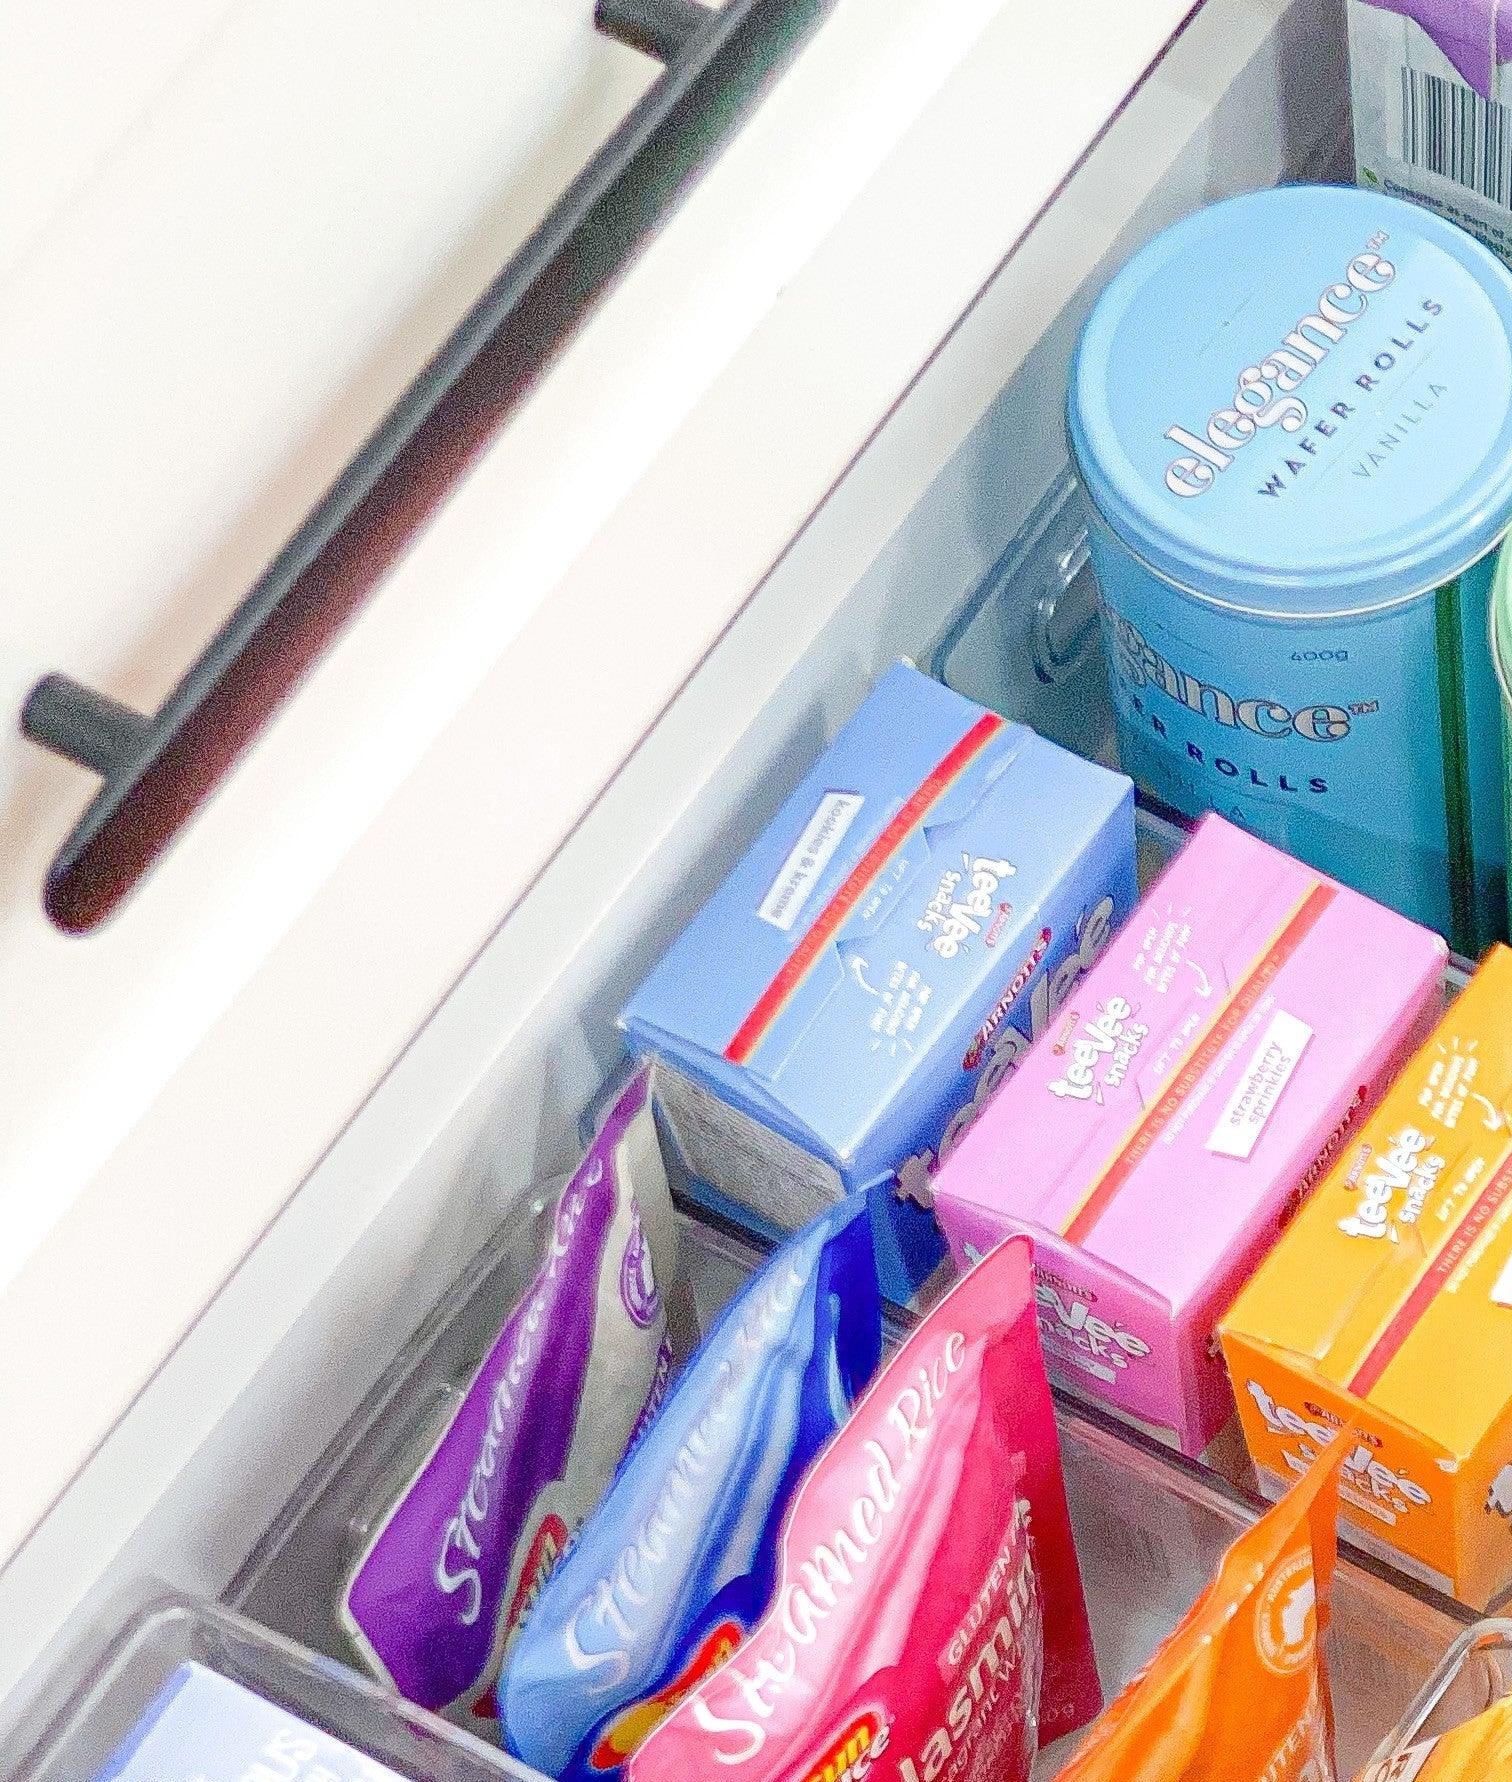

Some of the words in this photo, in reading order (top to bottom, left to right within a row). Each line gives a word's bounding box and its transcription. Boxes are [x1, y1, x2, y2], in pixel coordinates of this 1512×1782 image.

[1258, 399, 1355, 498] WAFER
[1355, 298, 1443, 391] ROLLS
[1352, 382, 1448, 479] VANILLA
[1291, 650, 1348, 663] 400g
[1187, 741, 1328, 793] ROLLS
[917, 870, 962, 934] snacks
[1104, 1019, 1149, 1087] snacks
[1159, 1095, 1179, 1118] NO
[1221, 1007, 1245, 1034] FOR
[1229, 1041, 1284, 1127] strawberry
[1247, 1052, 1292, 1125] sprinkles
[1398, 1157, 1447, 1225] snacks
[1436, 1237, 1469, 1276] THERE
[1462, 1222, 1480, 1239] IS
[1472, 1203, 1493, 1225] NO
[890, 1331, 966, 1462] Rice
[947, 1550, 1012, 1667] GLUTEN
